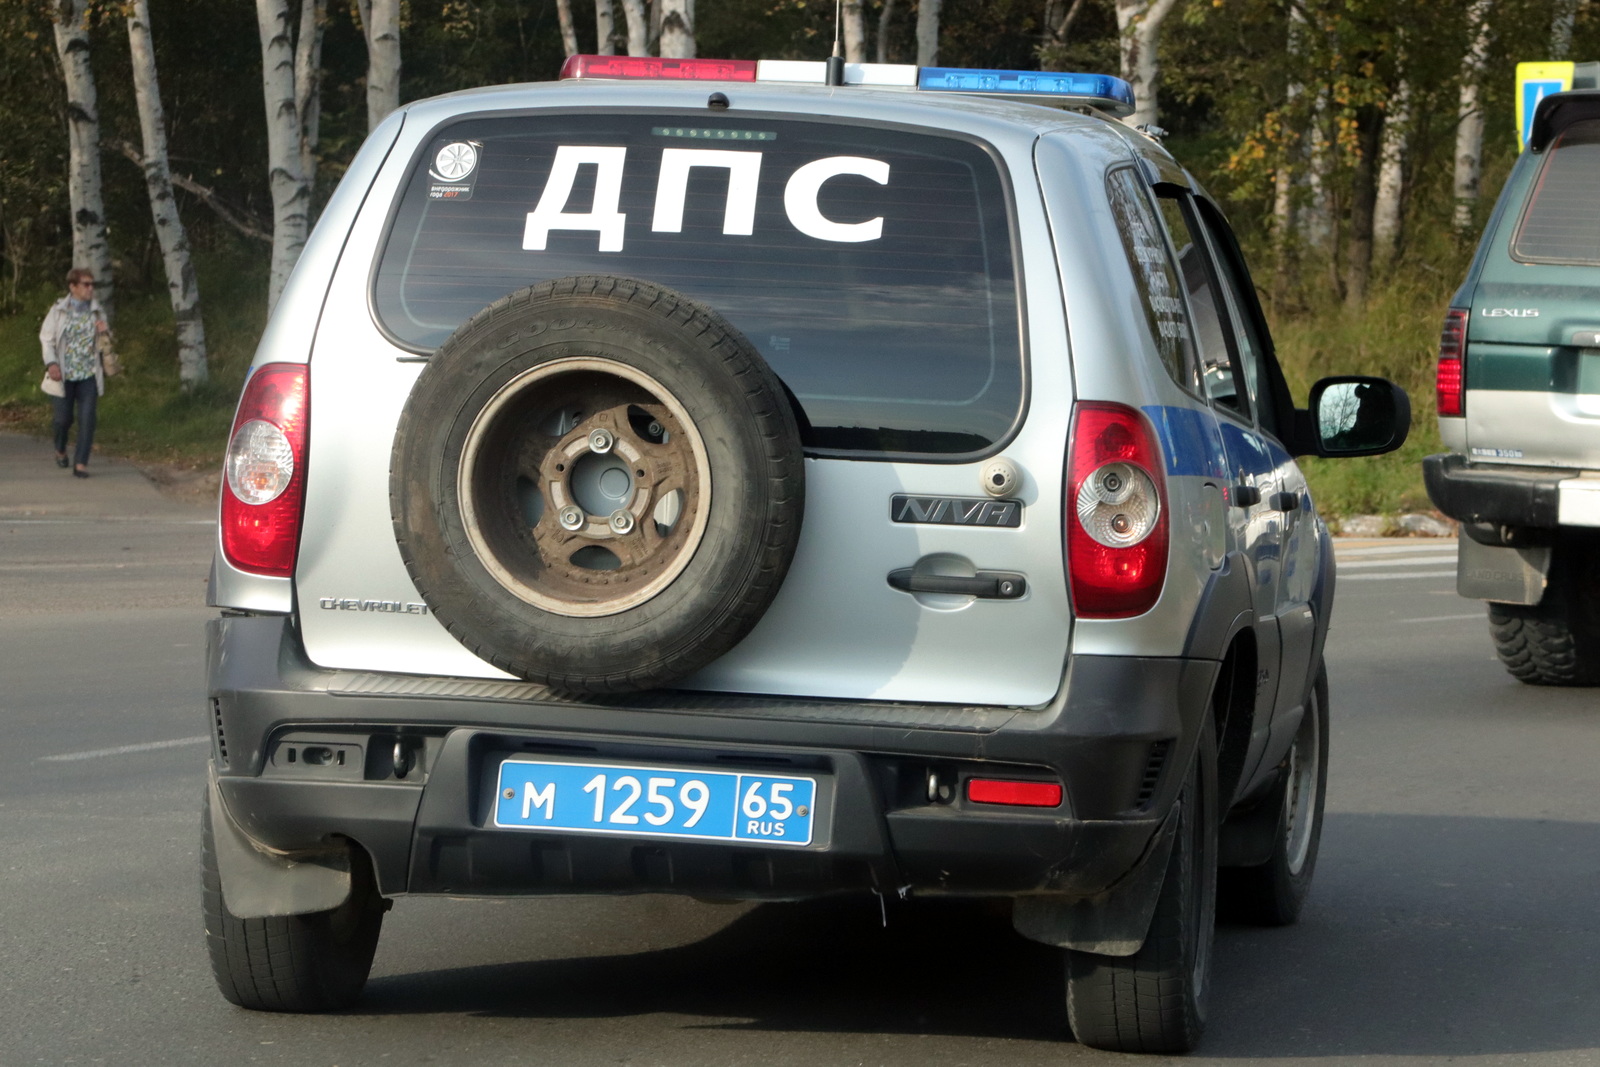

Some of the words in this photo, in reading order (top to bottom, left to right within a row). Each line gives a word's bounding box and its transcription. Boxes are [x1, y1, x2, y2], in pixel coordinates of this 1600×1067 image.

[522, 145, 890, 252] ДПС
[1481, 308, 1540, 318] LEXUS
[897, 498, 1016, 524] NIVA
[319, 597, 428, 615] CHEVROLET
[521, 781, 557, 820] M
[582, 774, 711, 828] 1259
[742, 781, 794, 821] 65
[746, 819, 786, 837] RUS
